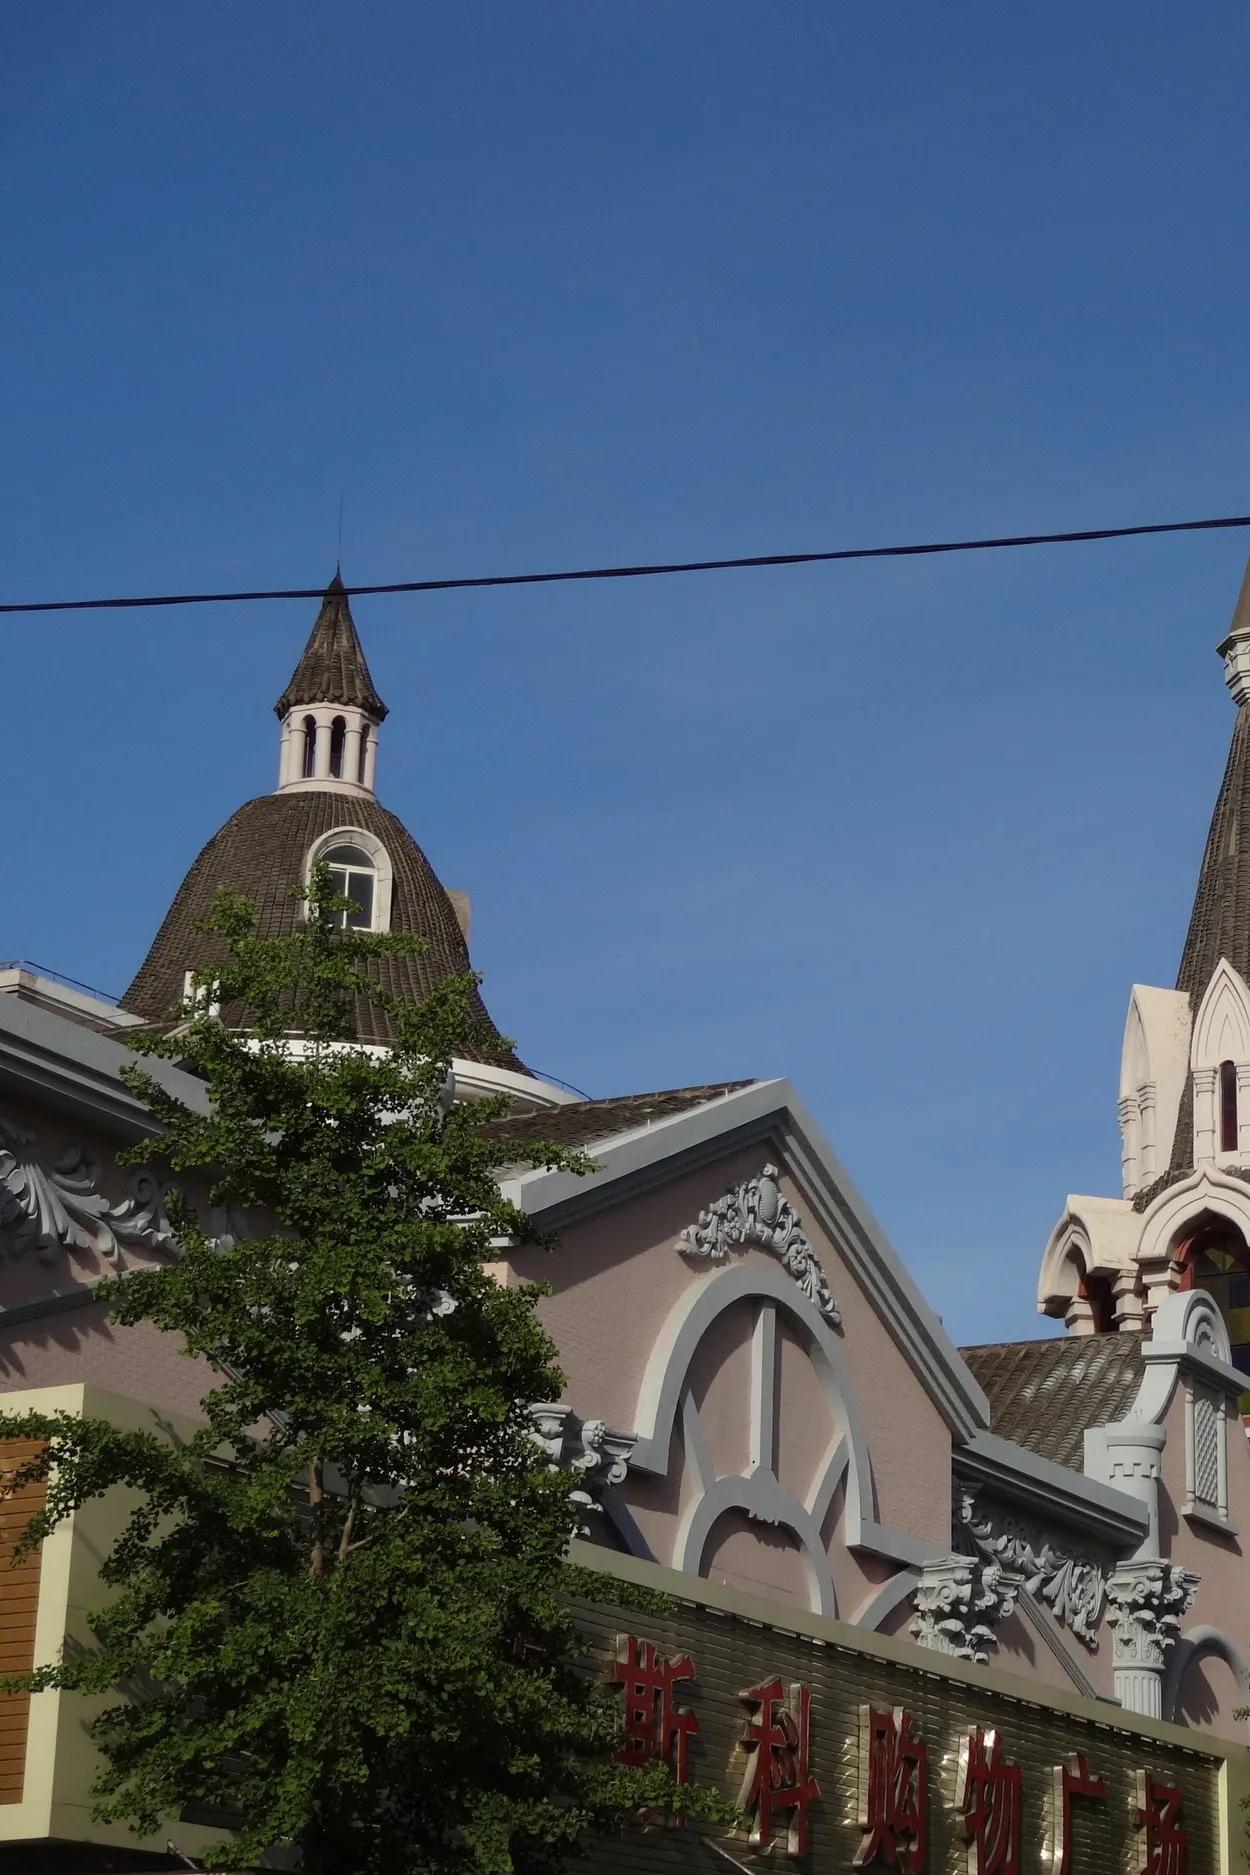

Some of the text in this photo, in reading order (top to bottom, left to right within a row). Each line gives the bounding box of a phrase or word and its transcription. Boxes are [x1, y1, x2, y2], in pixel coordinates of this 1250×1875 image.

[514, 1633, 1187, 1875] 斯科购物广场
